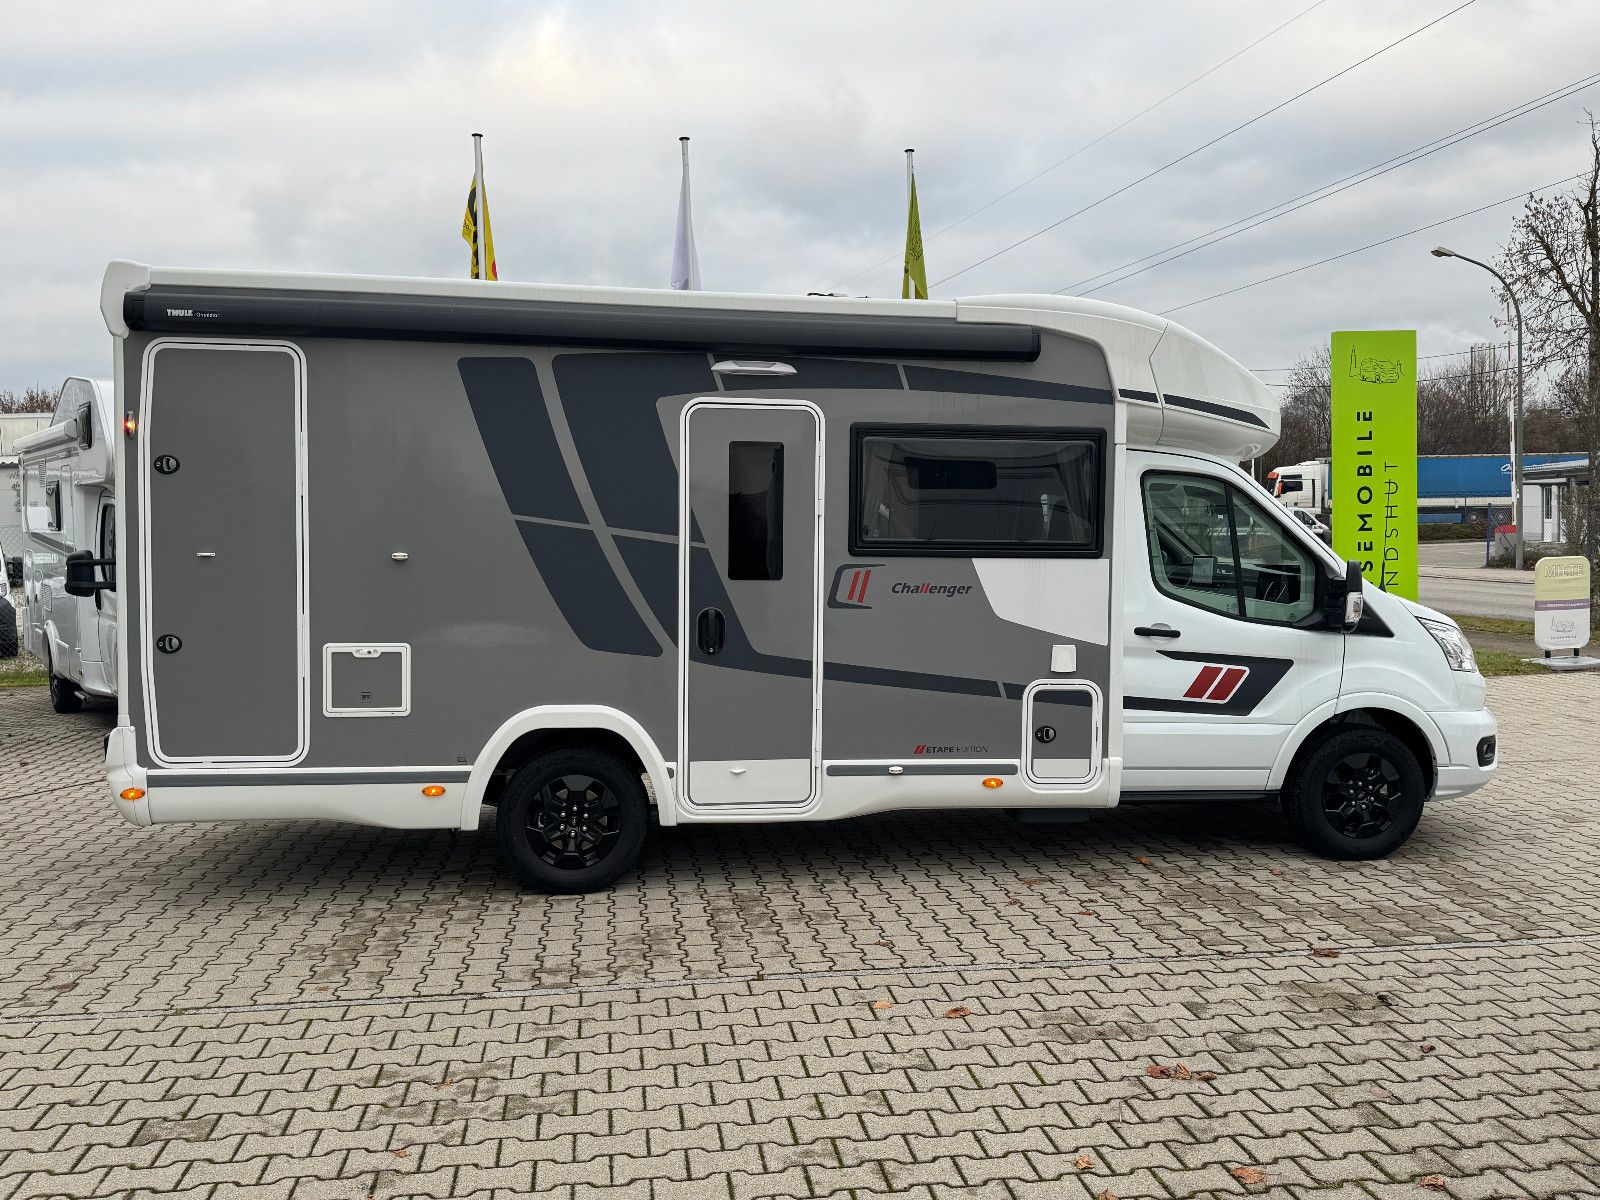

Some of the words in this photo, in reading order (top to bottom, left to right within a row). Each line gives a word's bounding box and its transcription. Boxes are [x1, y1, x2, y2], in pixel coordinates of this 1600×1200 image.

[166, 309, 193, 317] THULE
[1356, 411, 1374, 585] SEMOBILE
[1544, 563, 1584, 578] MIETE
[891, 582, 972, 597] Challenger
